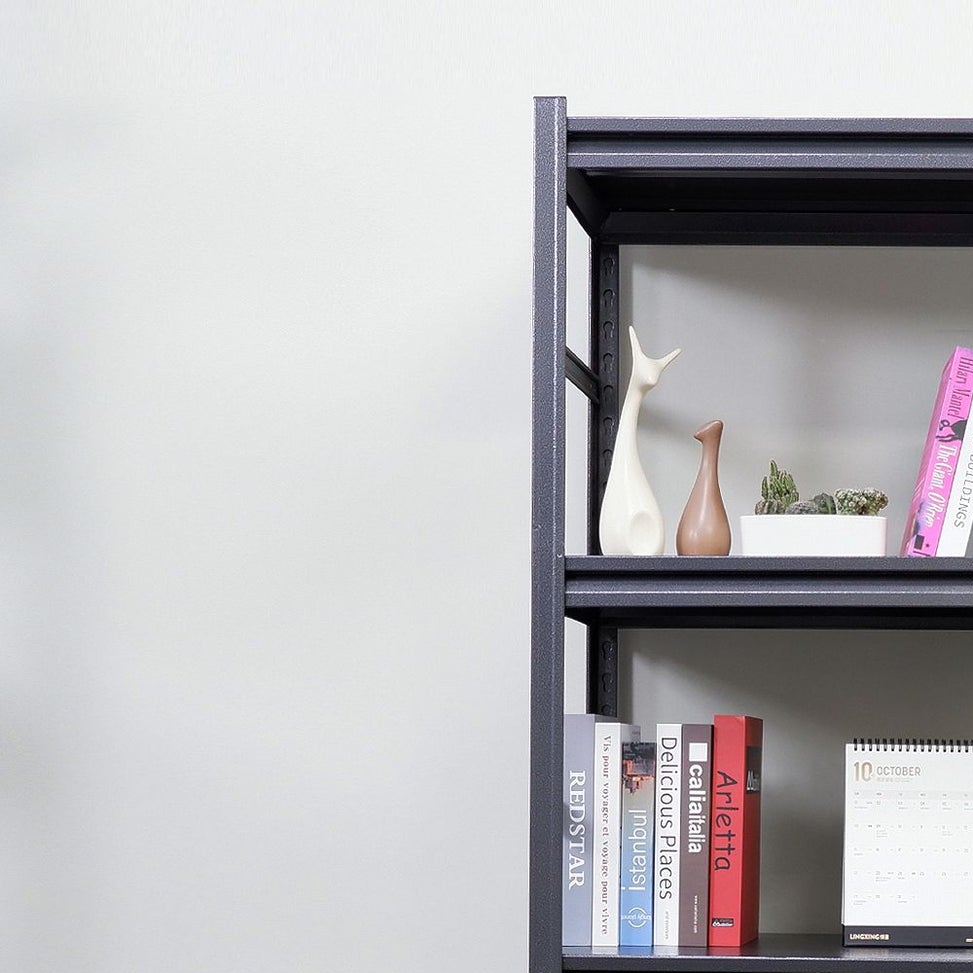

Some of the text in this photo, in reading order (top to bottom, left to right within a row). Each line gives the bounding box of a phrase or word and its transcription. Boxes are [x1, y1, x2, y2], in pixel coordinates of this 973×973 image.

[936, 444, 957, 461] The
[603, 735, 612, 752] Vis
[601, 756, 610, 779] pour
[853, 761, 921, 783] 10 OCTOBER
[601, 783, 610, 822] voyager
[688, 764, 707, 853] caliaitalia
[568, 770, 586, 890] REDSTAR
[602, 826, 609, 837] et
[659, 737, 678, 900] Delicious Places
[714, 770, 738, 871] Arletta
[600, 841, 609, 877] voyage
[600, 881, 608, 904] pour
